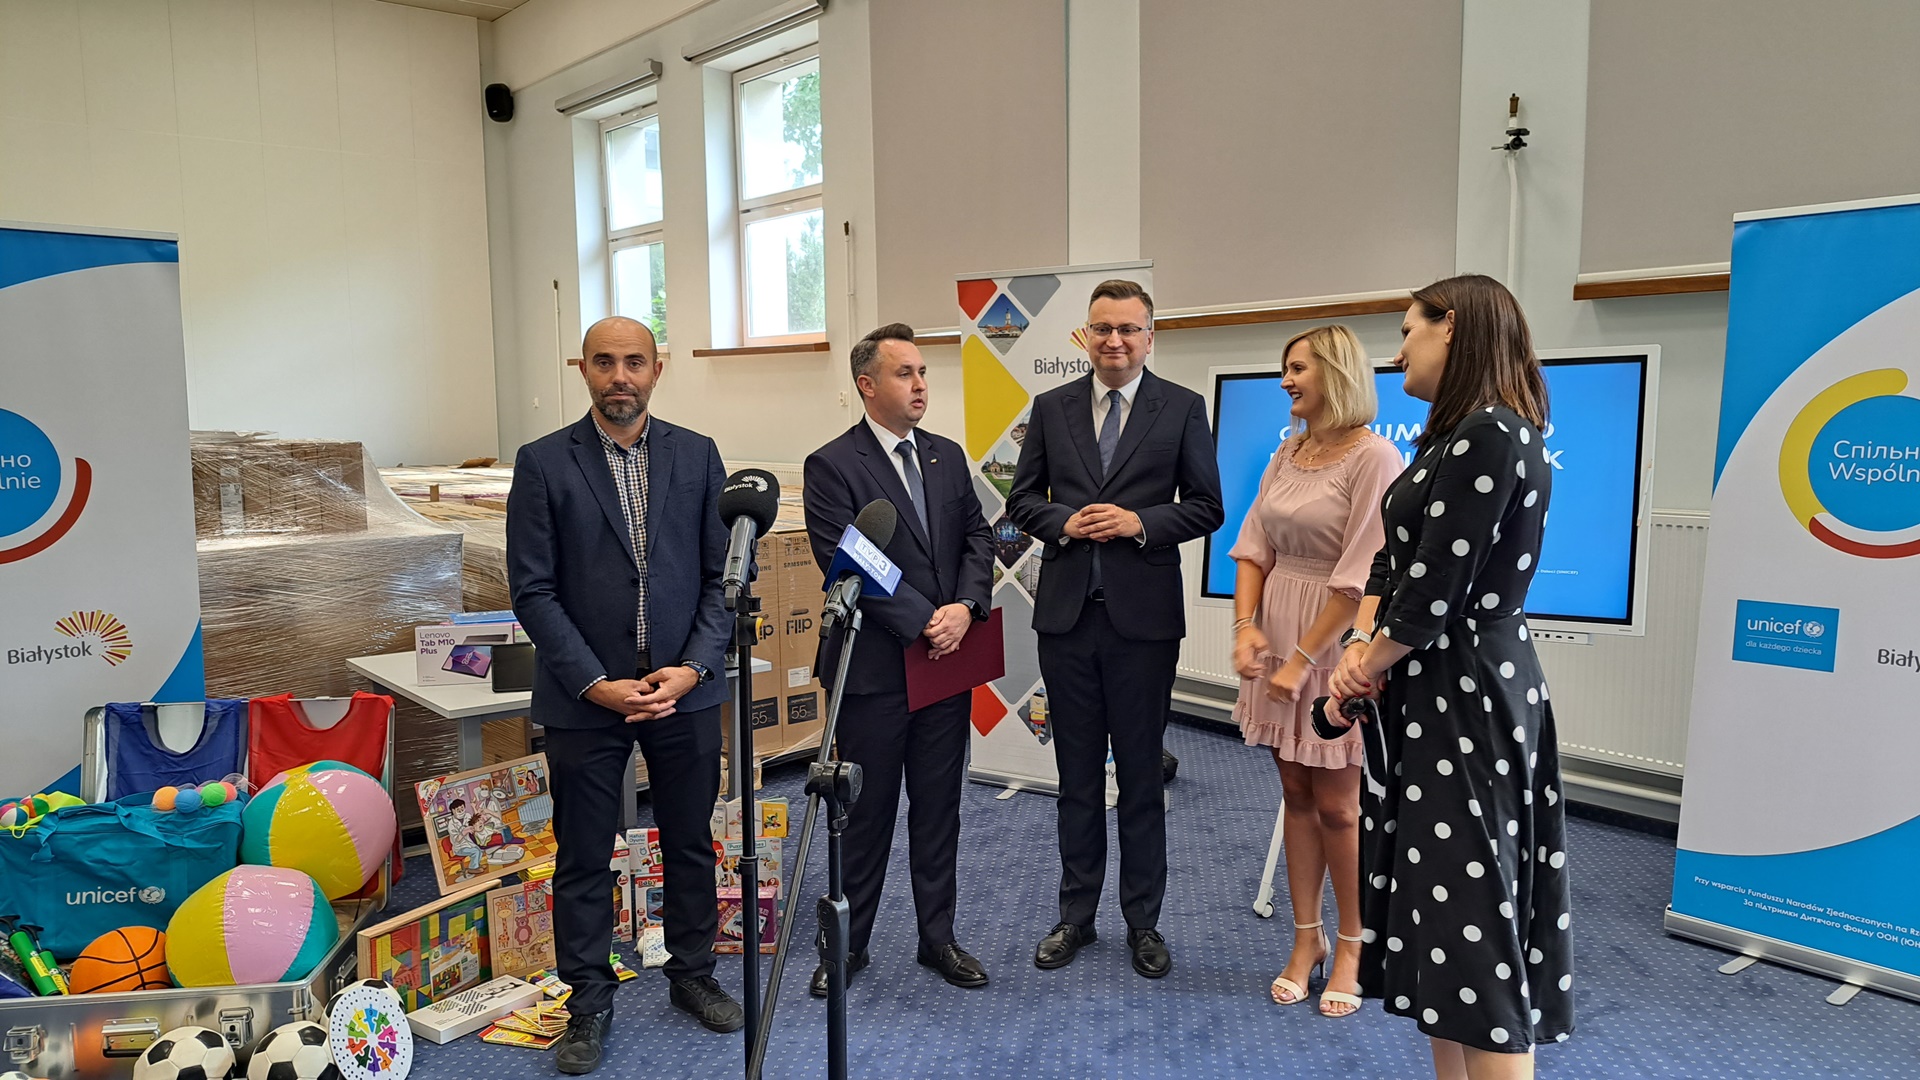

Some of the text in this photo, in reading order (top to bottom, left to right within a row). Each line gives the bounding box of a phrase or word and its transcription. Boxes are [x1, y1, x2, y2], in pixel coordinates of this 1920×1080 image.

[1034, 356, 1091, 378] Białysto
[1833, 440, 1919, 460] Спільн
[0, 471, 41, 490] lnie
[1828, 462, 1920, 485] Wspóln
[784, 560, 812, 568] SAMSUNG
[1747, 617, 1803, 635] unicef
[7, 640, 93, 665] Białystok
[1759, 641, 1791, 652] każdego
[1793, 645, 1822, 655] dziecka
[1878, 648, 1920, 673] Biały
[791, 705, 807, 719] 55
[66, 886, 137, 905] unicef
[1694, 876, 1920, 937] Przy wsparciu Funduszu Narodów Zjednoczonych na Rz
[1743, 898, 1753, 907] За
[1800, 912, 1841, 929] Дитячого
[1843, 923, 1874, 938] фонду
[1876, 931, 1898, 943] ООН
[1900, 936, 1920, 949] (ЮН
